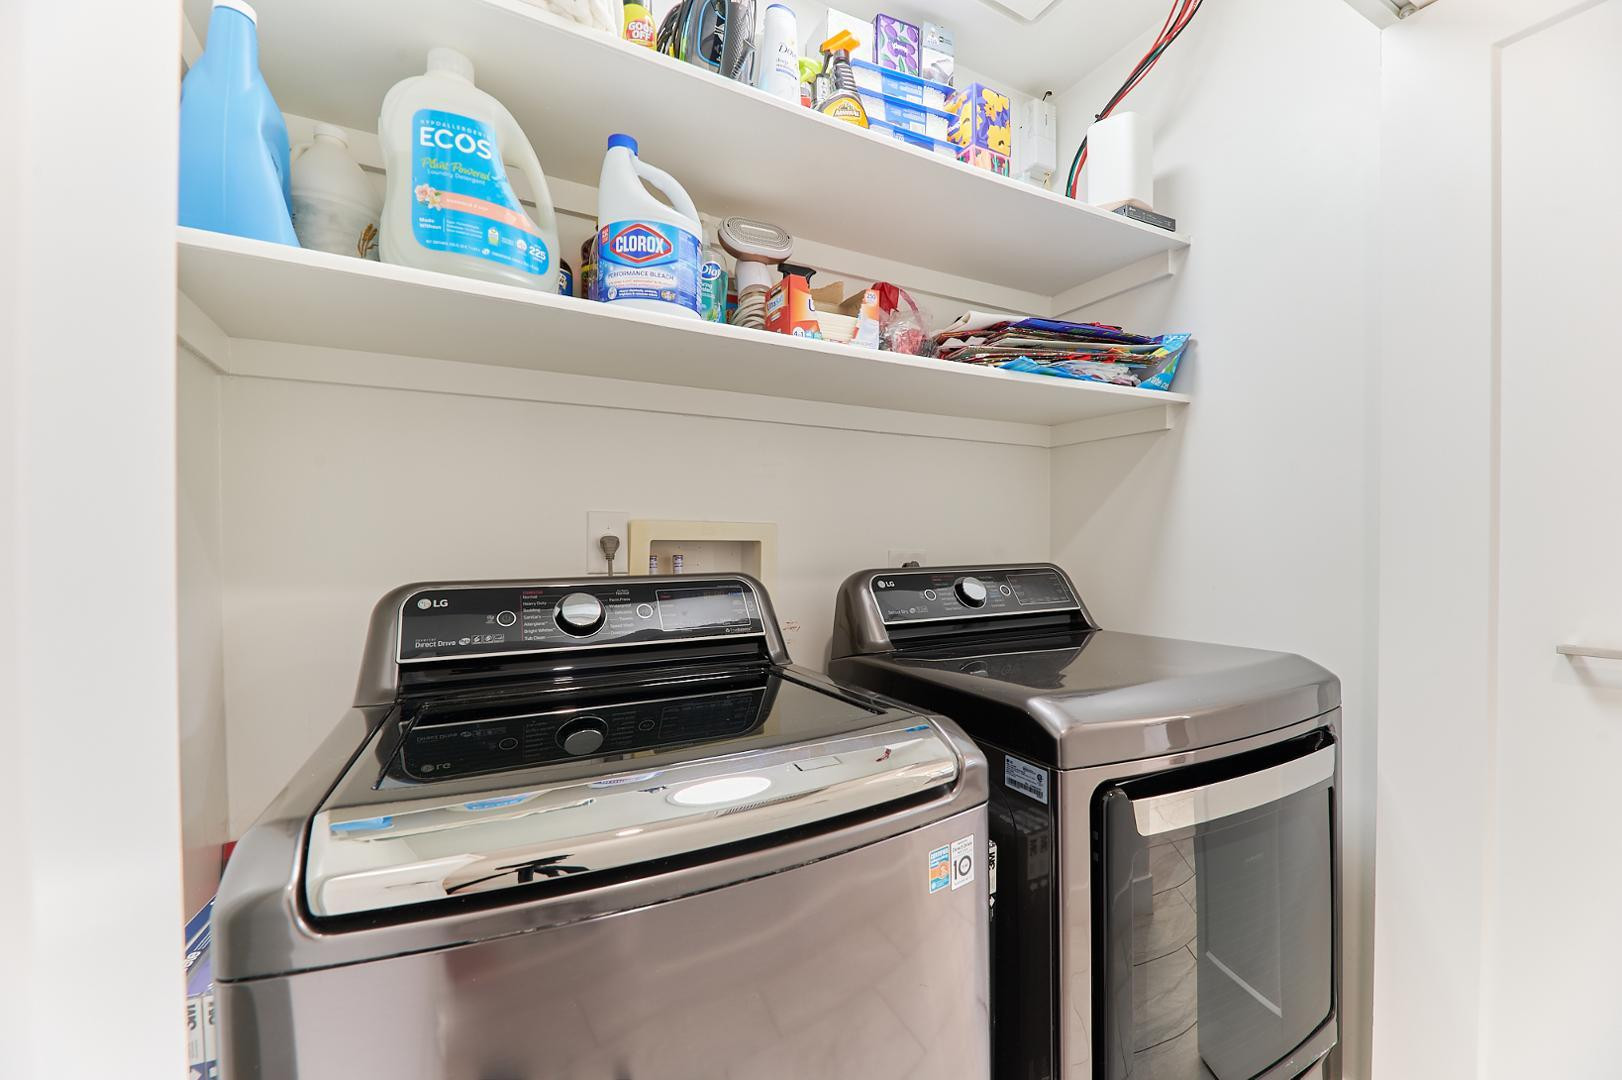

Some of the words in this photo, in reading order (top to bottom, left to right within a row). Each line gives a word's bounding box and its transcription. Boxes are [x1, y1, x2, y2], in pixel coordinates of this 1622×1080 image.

[631, 30, 651, 41] OFF
[420, 126, 492, 159] ECOS
[615, 235, 664, 254] CLOROX
[529, 245, 547, 261] 225
[649, 271, 674, 281] BLEACH
[433, 599, 449, 608] LG
[415, 641, 437, 649] Direct
[437, 640, 457, 648] Drive
